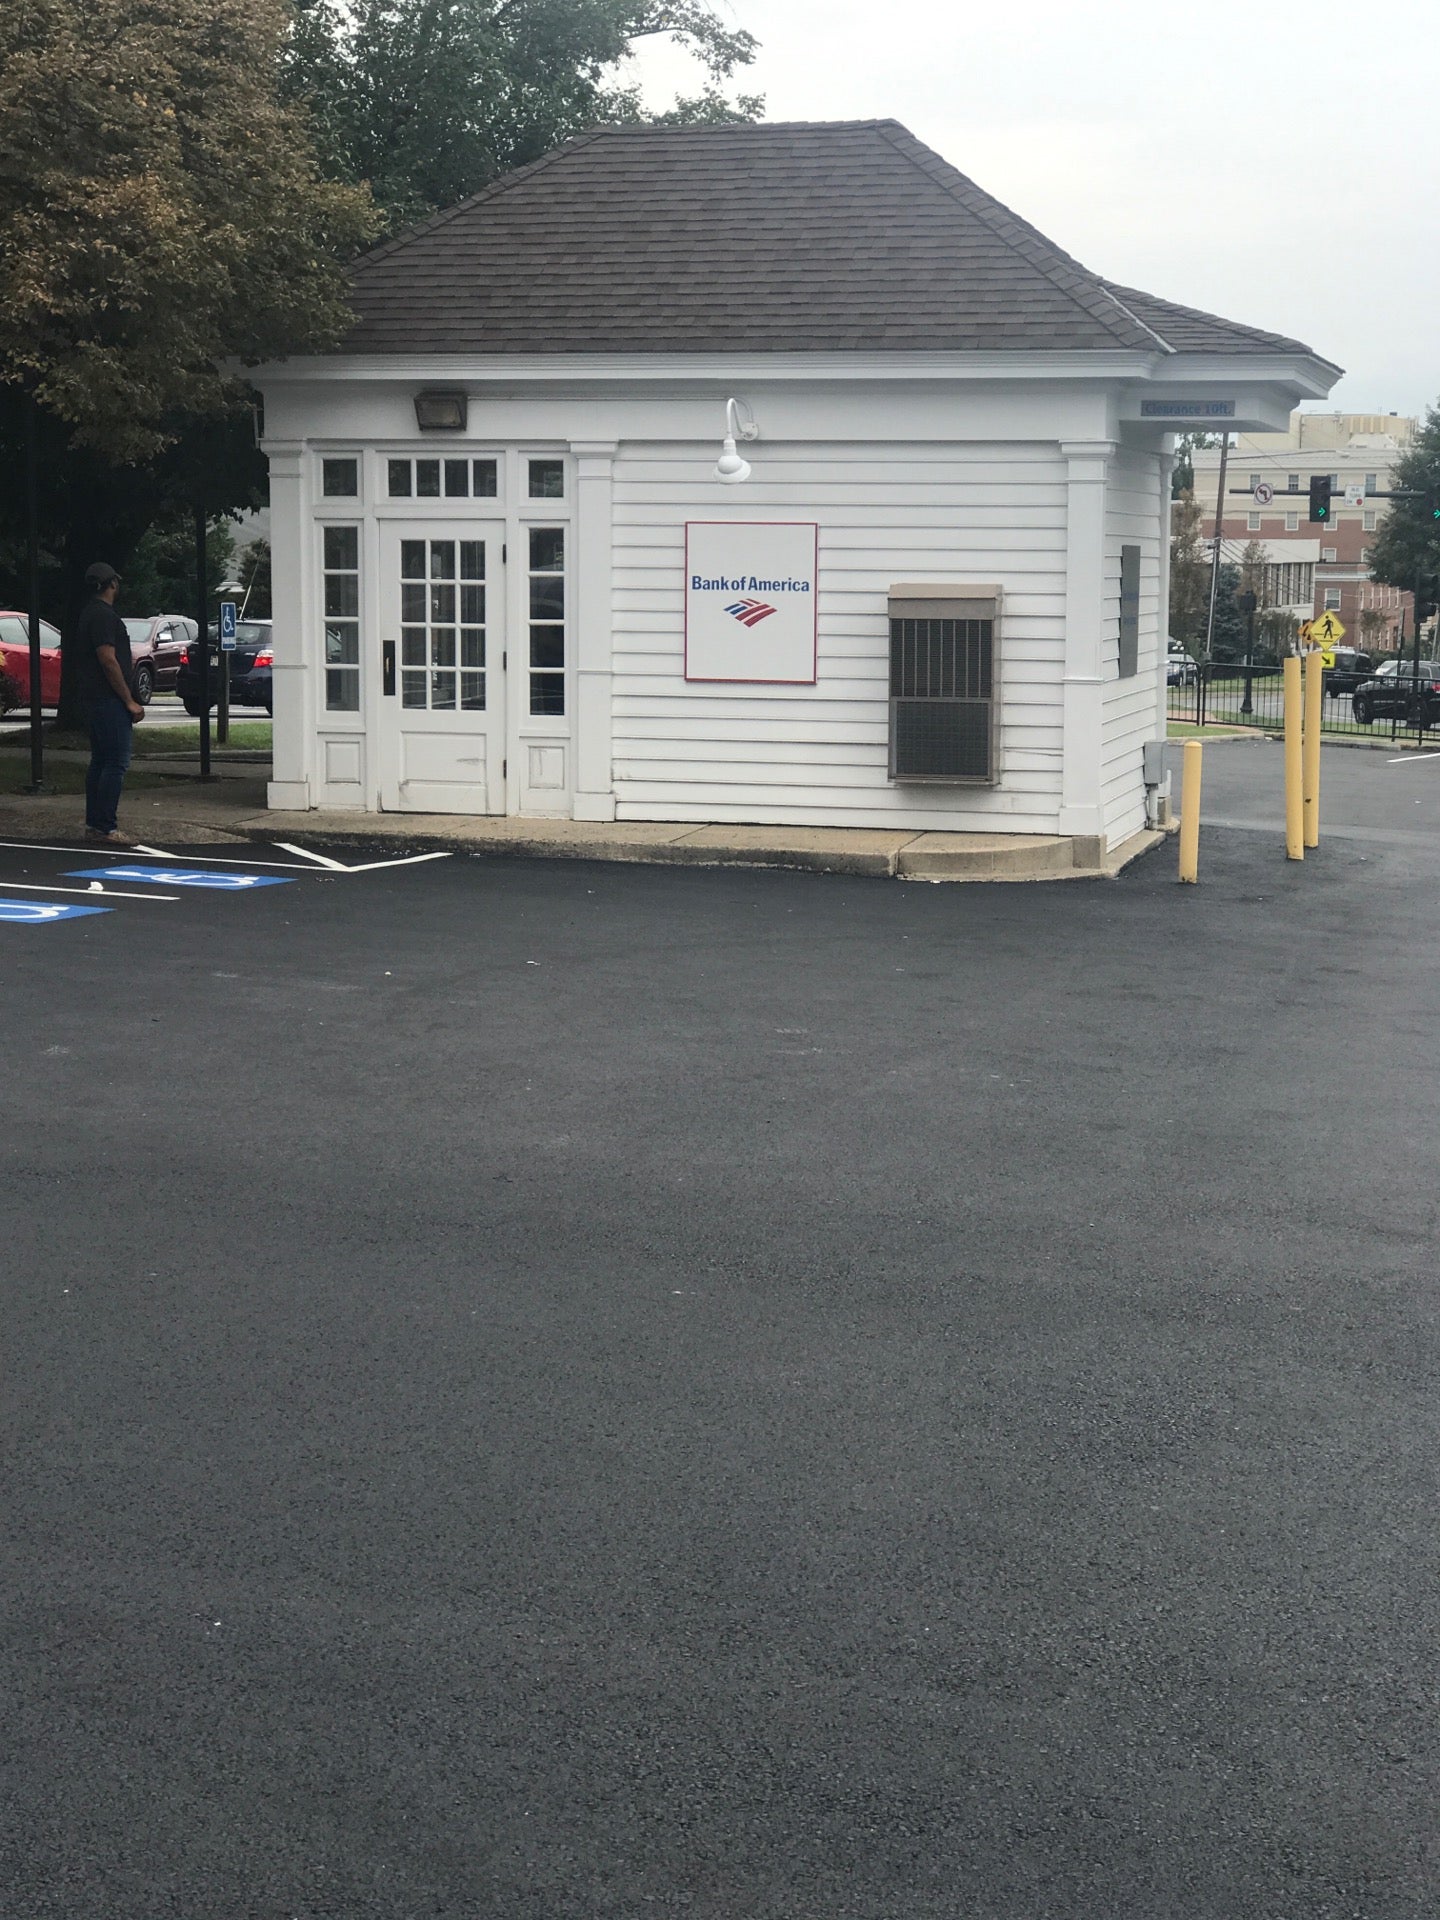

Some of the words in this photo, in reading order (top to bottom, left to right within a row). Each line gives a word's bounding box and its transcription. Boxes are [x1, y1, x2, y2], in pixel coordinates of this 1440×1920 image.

[692, 575, 730, 591] Bank
[731, 576, 747, 591] of
[748, 576, 810, 592] America
